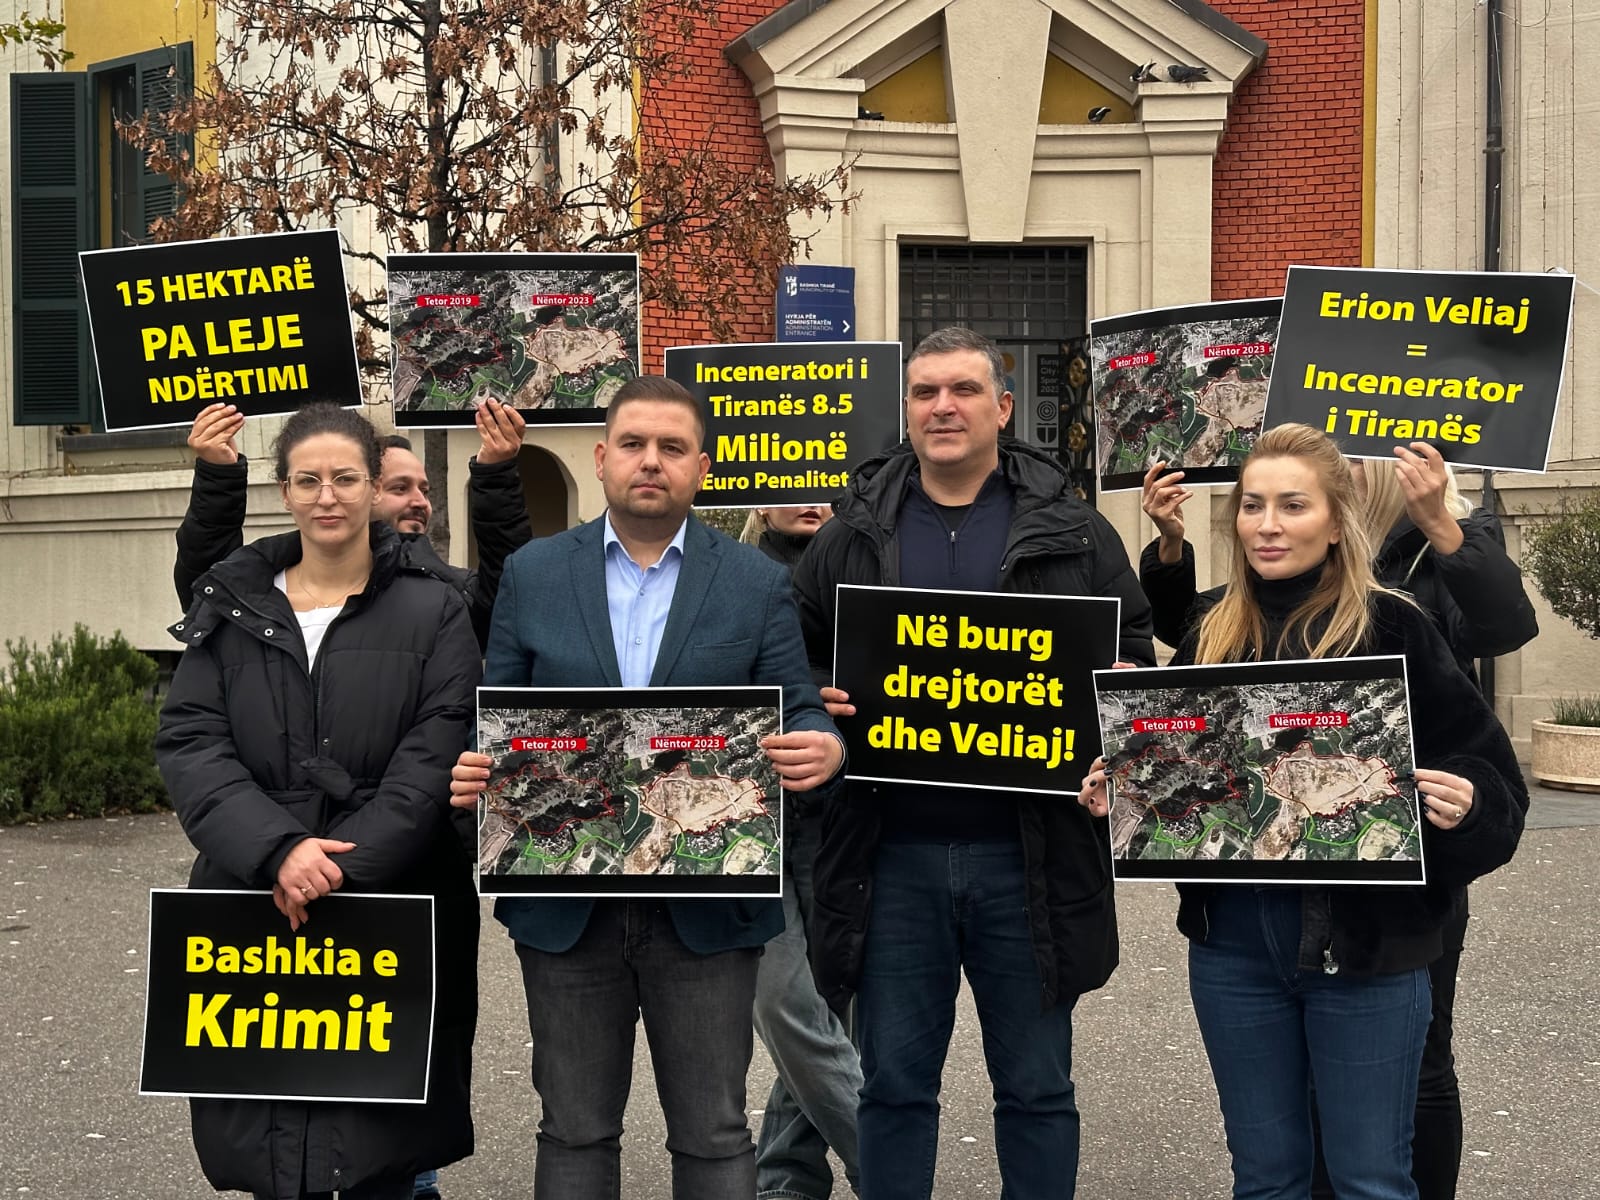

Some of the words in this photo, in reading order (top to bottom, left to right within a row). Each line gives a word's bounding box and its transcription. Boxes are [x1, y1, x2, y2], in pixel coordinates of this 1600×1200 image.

[116, 278, 155, 307] 15
[161, 256, 315, 303] HEKTARË
[425, 297, 448, 305] Tetor
[450, 297, 471, 305] 2019
[536, 295, 566, 304] Nëntor
[568, 296, 589, 304] 2023
[1320, 291, 1415, 321] Erion
[1424, 295, 1530, 334] Veliaj
[141, 324, 197, 362] PA
[204, 313, 304, 356] LEJE
[1208, 347, 1240, 357] Nëntor
[1242, 345, 1265, 355] 2023
[696, 358, 854, 383] Inceneratori
[860, 357, 868, 379] i
[1115, 358, 1131, 367] Tetor
[1132, 355, 1149, 365] 2019
[148, 363, 309, 404] NDËRTIMI
[1303, 363, 1524, 404] Incenerator
[709, 394, 807, 417] Tiranës
[812, 393, 854, 415] 8.5
[1325, 406, 1338, 434] i
[1345, 408, 1482, 445] Tiranës
[716, 431, 848, 463] Milionë
[754, 470, 849, 490] Penalitet
[896, 614, 949, 648] Në
[958, 616, 1053, 662] burg
[883, 664, 1064, 710] drejtorët
[1142, 721, 1168, 731] Tetor
[1171, 720, 1196, 730] 2019
[1274, 716, 1312, 727] Nëntor
[1314, 715, 1342, 726] 2023
[521, 739, 548, 749] Tetor
[551, 739, 577, 749] 2019
[655, 737, 693, 748] Nëntor
[694, 738, 720, 748] 2023
[867, 716, 942, 752] dhe
[949, 721, 1076, 769] Veliaj!
[185, 935, 361, 976] Bashkia
[373, 949, 399, 977] e
[185, 991, 393, 1053] Krimit
